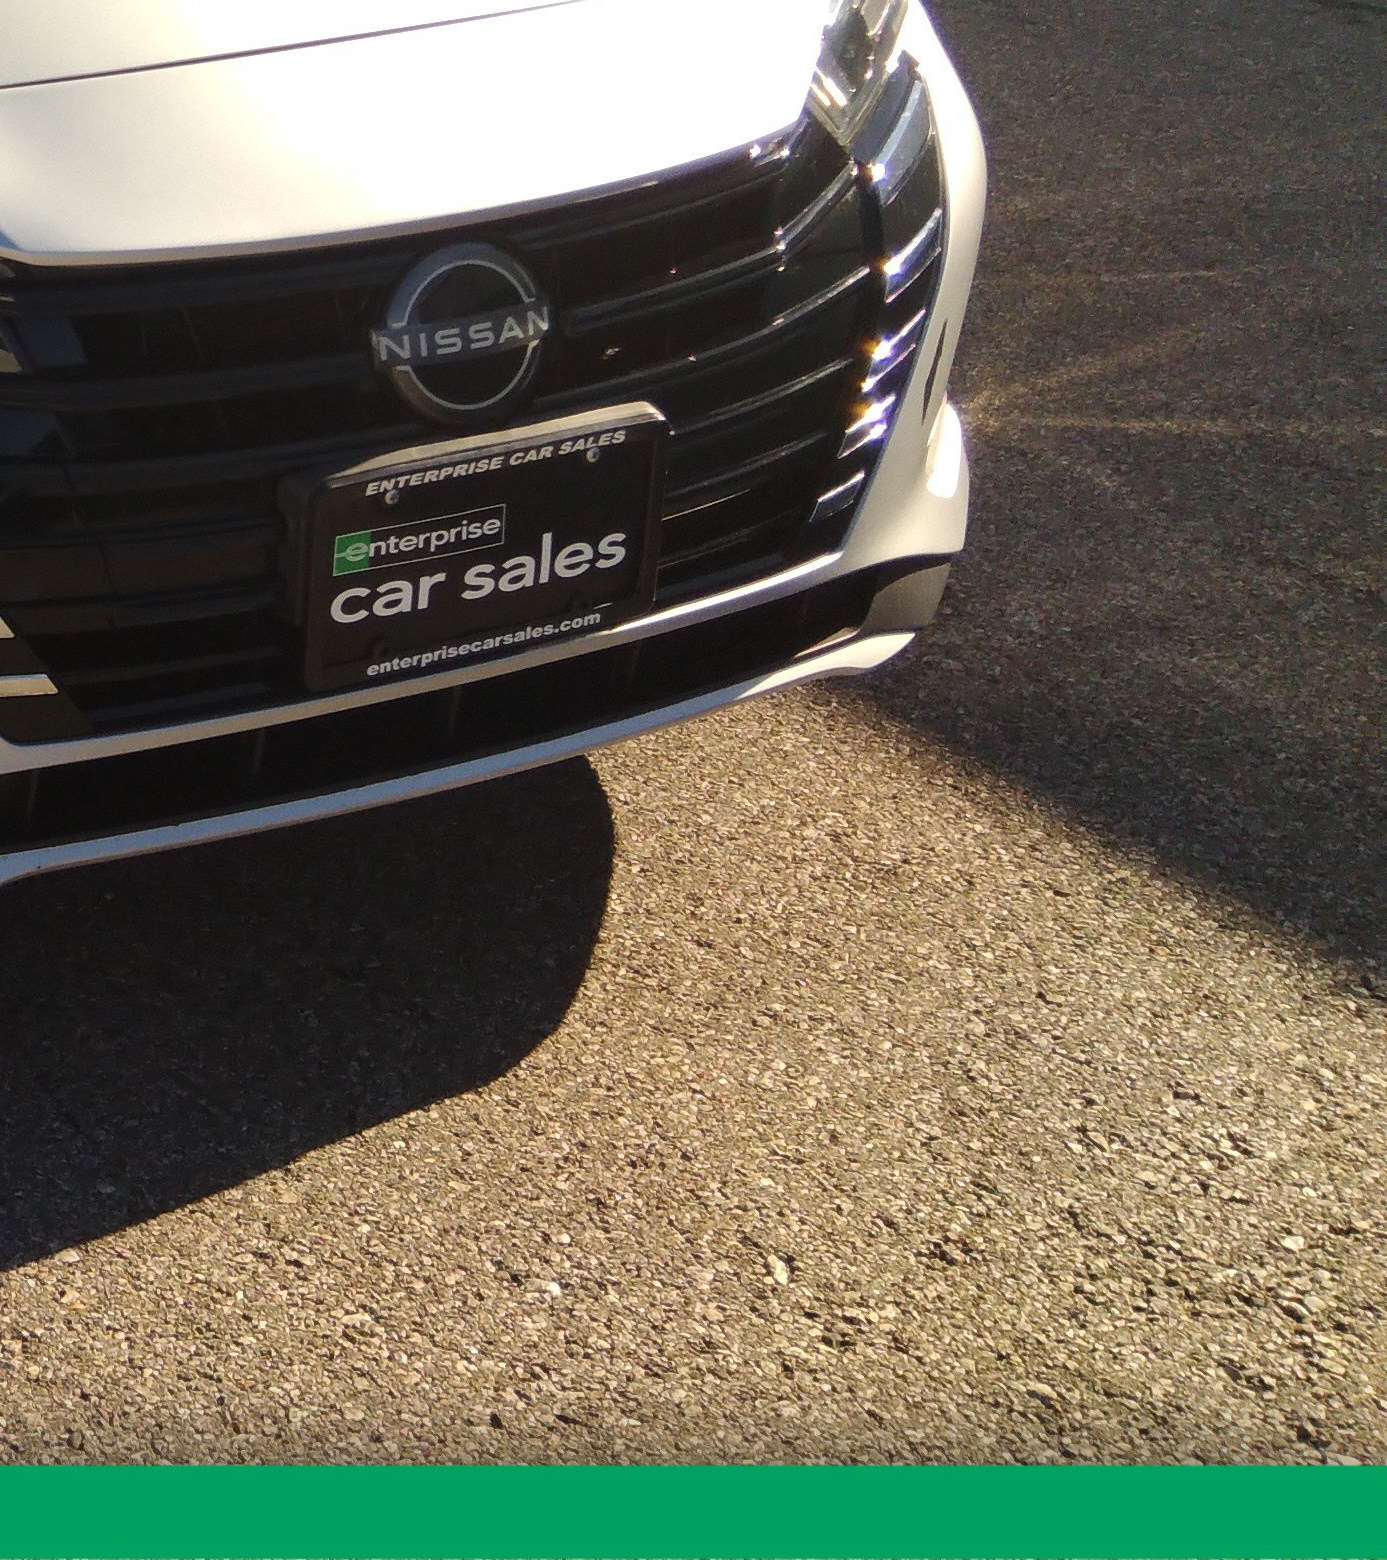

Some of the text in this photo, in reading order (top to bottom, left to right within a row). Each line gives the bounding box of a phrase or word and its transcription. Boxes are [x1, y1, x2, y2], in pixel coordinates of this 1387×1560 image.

[377, 306, 549, 361] NISSAN
[365, 430, 626, 497] ENTERPRISE CAR SALES
[337, 517, 501, 562] enterprise
[330, 532, 627, 623] car sales
[366, 611, 601, 676] enterprisecarsales.com
